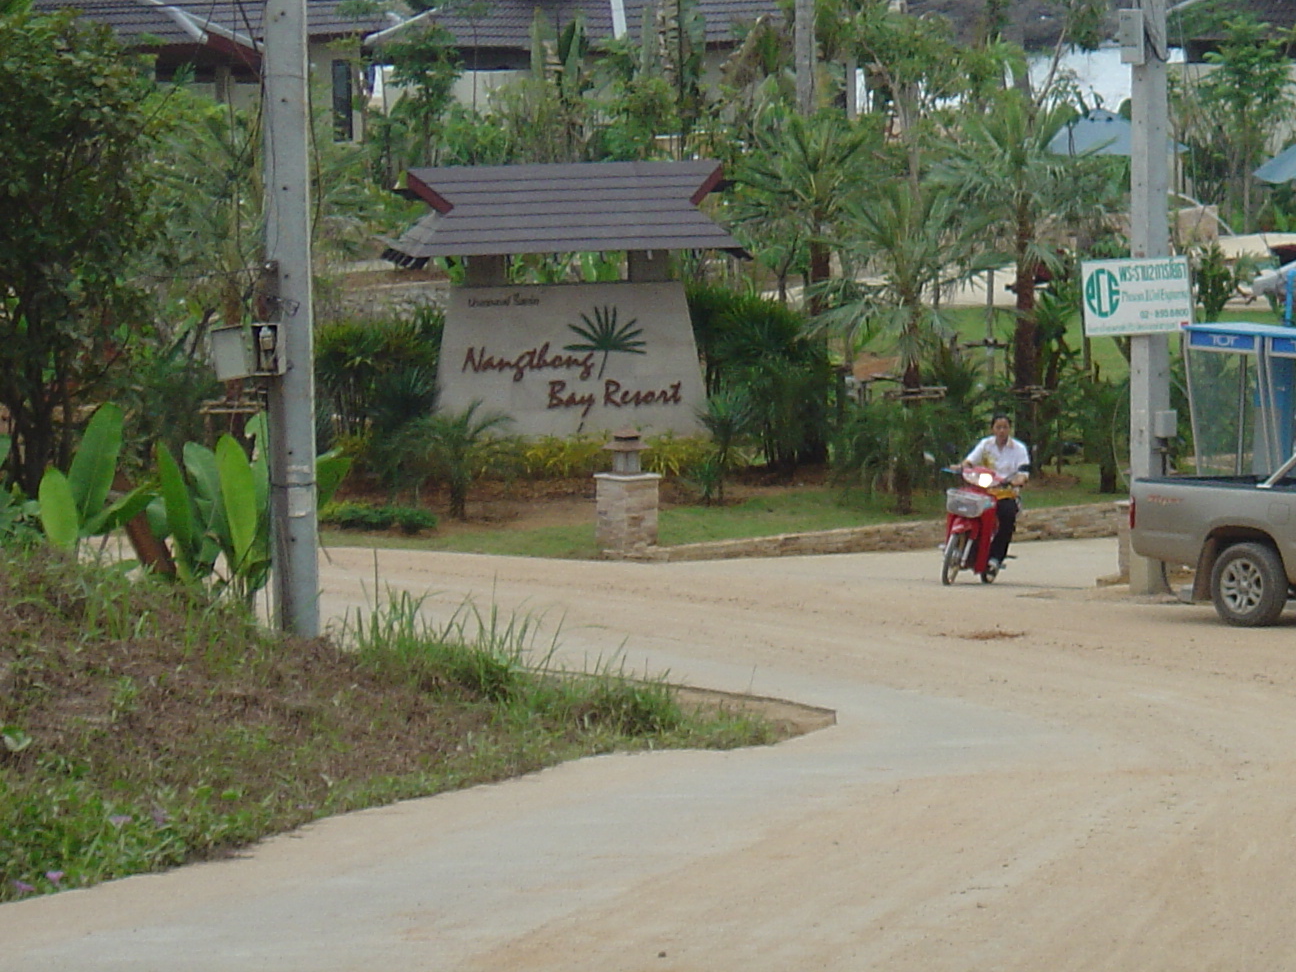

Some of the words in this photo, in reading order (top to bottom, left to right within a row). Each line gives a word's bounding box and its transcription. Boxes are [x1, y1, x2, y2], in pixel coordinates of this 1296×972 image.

[1086, 268, 1120, 318] PCE
[1209, 335, 1239, 346] TOT
[462, 341, 595, 382] Nangthong
[548, 380, 595, 418] Bay
[604, 379, 682, 407] Resort
